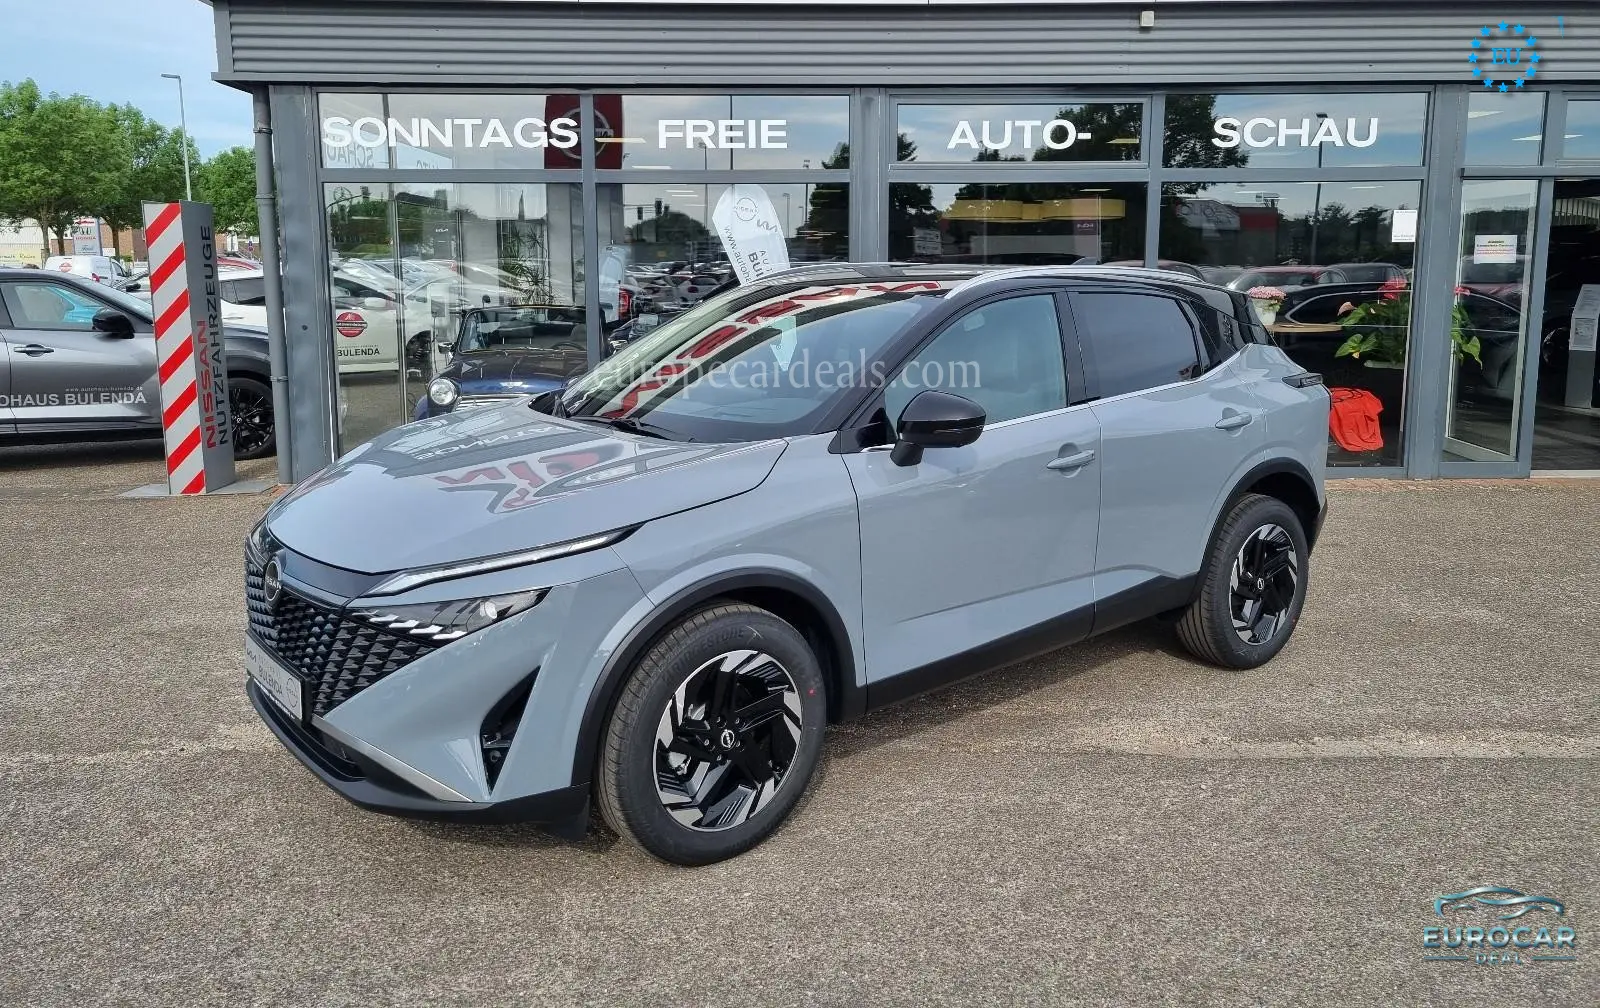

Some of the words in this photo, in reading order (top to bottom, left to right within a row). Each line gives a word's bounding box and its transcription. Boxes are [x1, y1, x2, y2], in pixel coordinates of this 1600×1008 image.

[323, 117, 578, 148] SONNTAGS
[658, 119, 788, 149] FREIE
[947, 119, 1091, 150] AUTO-
[1211, 117, 1379, 148] SCHAU
[200, 225, 229, 445] NUTZFAHRZEUGE
[64, 391, 148, 405] BULENDA
[197, 319, 217, 449] NISSAN
